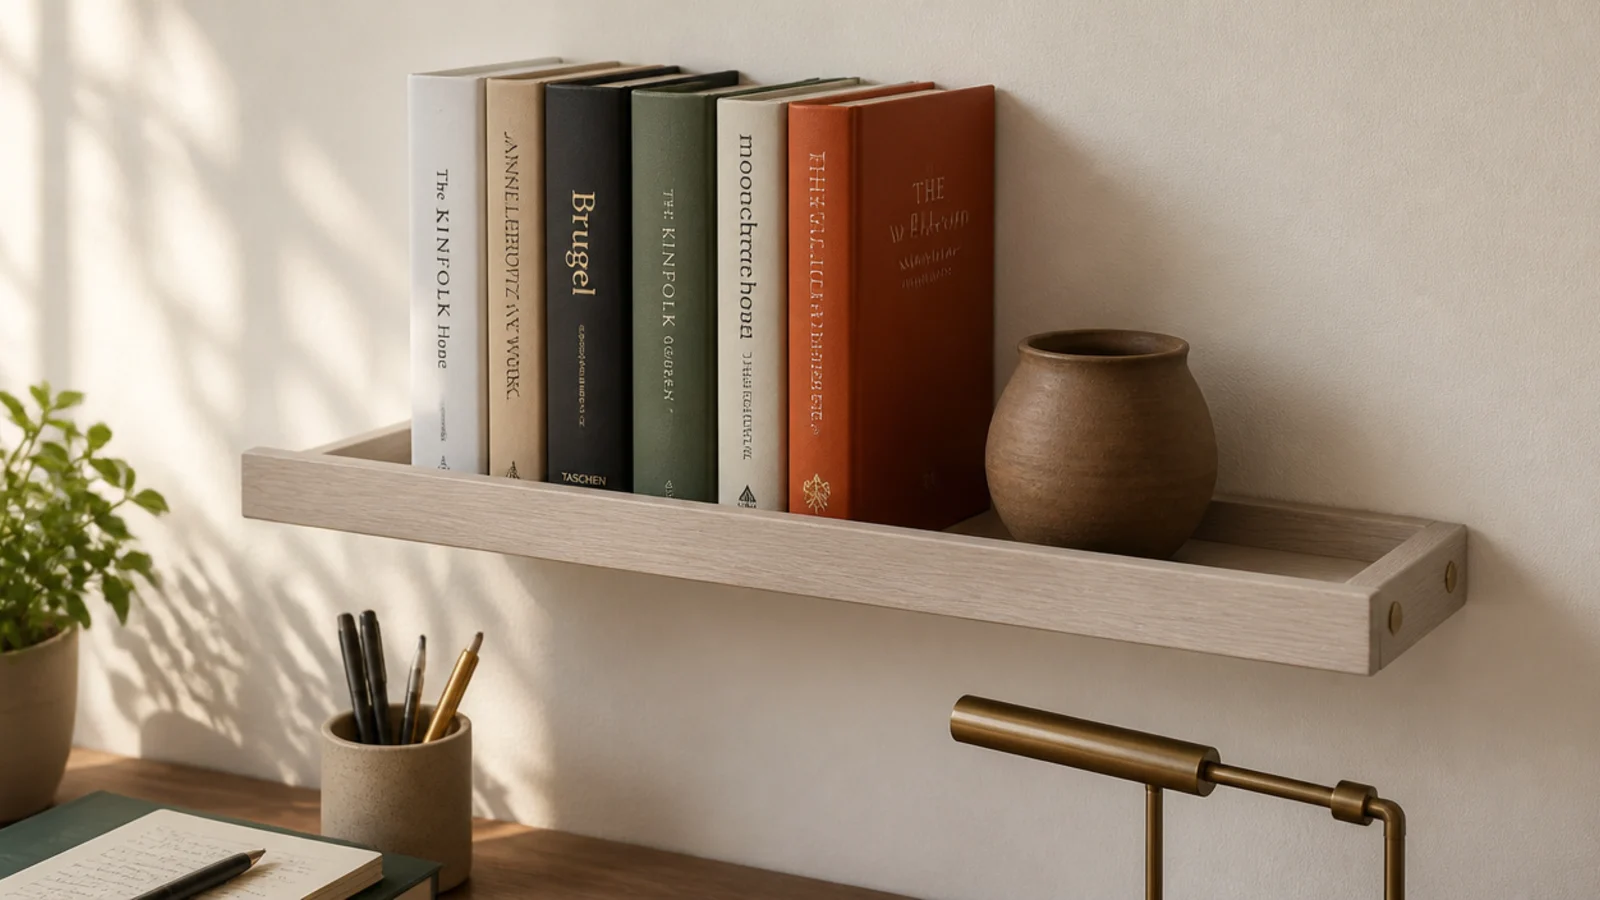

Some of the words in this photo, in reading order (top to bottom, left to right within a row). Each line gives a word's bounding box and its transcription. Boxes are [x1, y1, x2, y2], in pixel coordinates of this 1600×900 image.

[436, 169, 449, 201] The
[912, 176, 945, 205] THE
[436, 208, 451, 317] KINFOLK
[565, 190, 596, 296] Brugel
[662, 227, 676, 328] KINFOLK
[561, 472, 607, 486] TASCHEN
